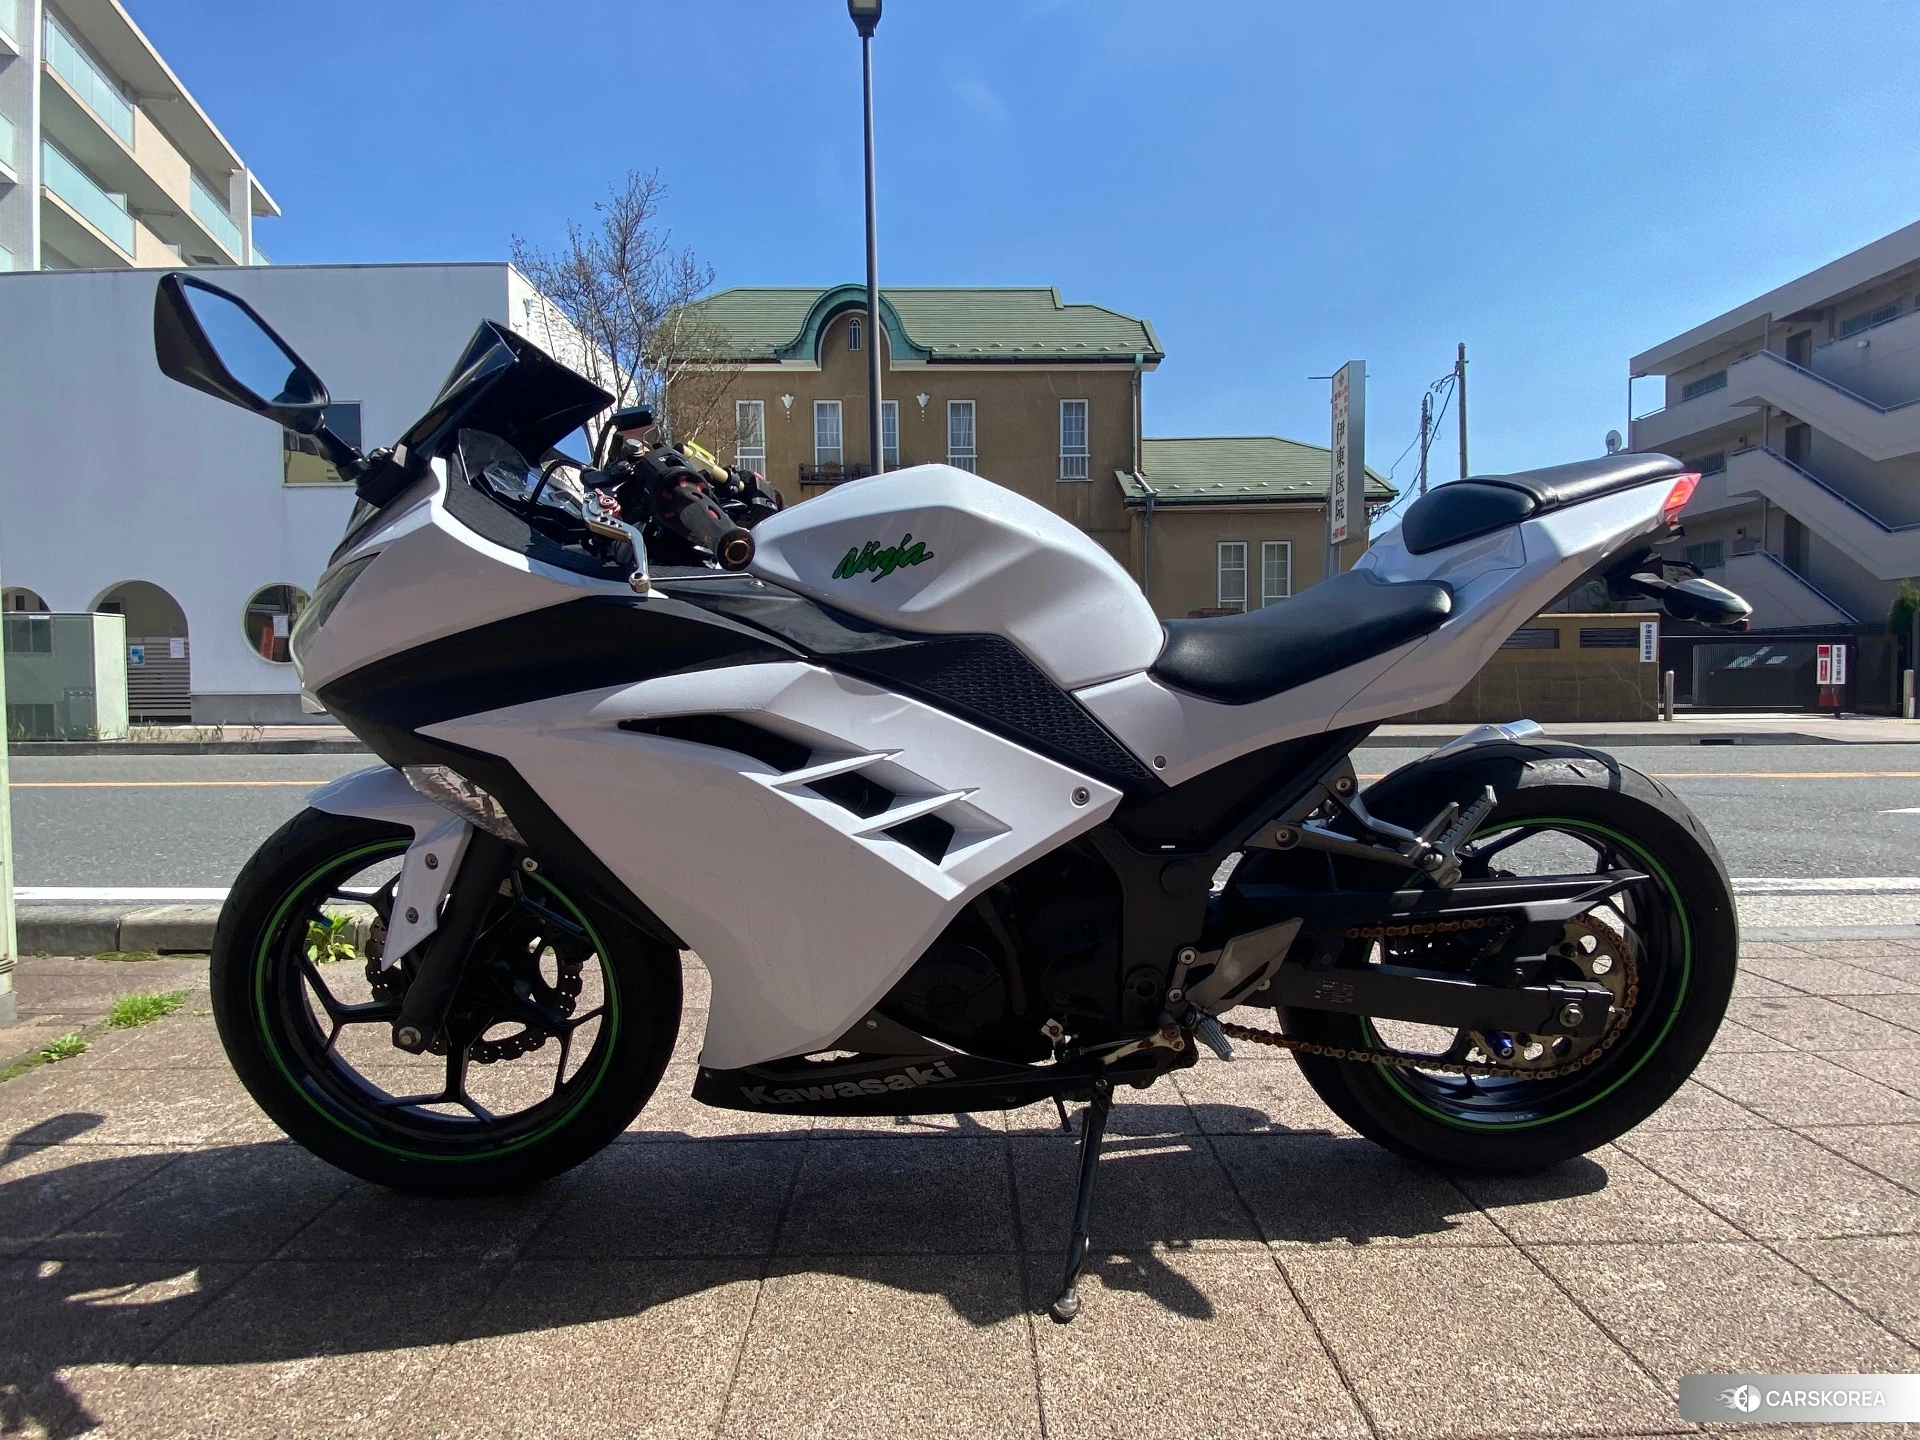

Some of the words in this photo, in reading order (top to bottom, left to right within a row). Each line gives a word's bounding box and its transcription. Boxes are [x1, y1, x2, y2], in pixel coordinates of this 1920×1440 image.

[1335, 420, 1346, 522] 伊東医院
[832, 533, 934, 583] Ninja
[739, 1060, 957, 1105] Kawasaki
